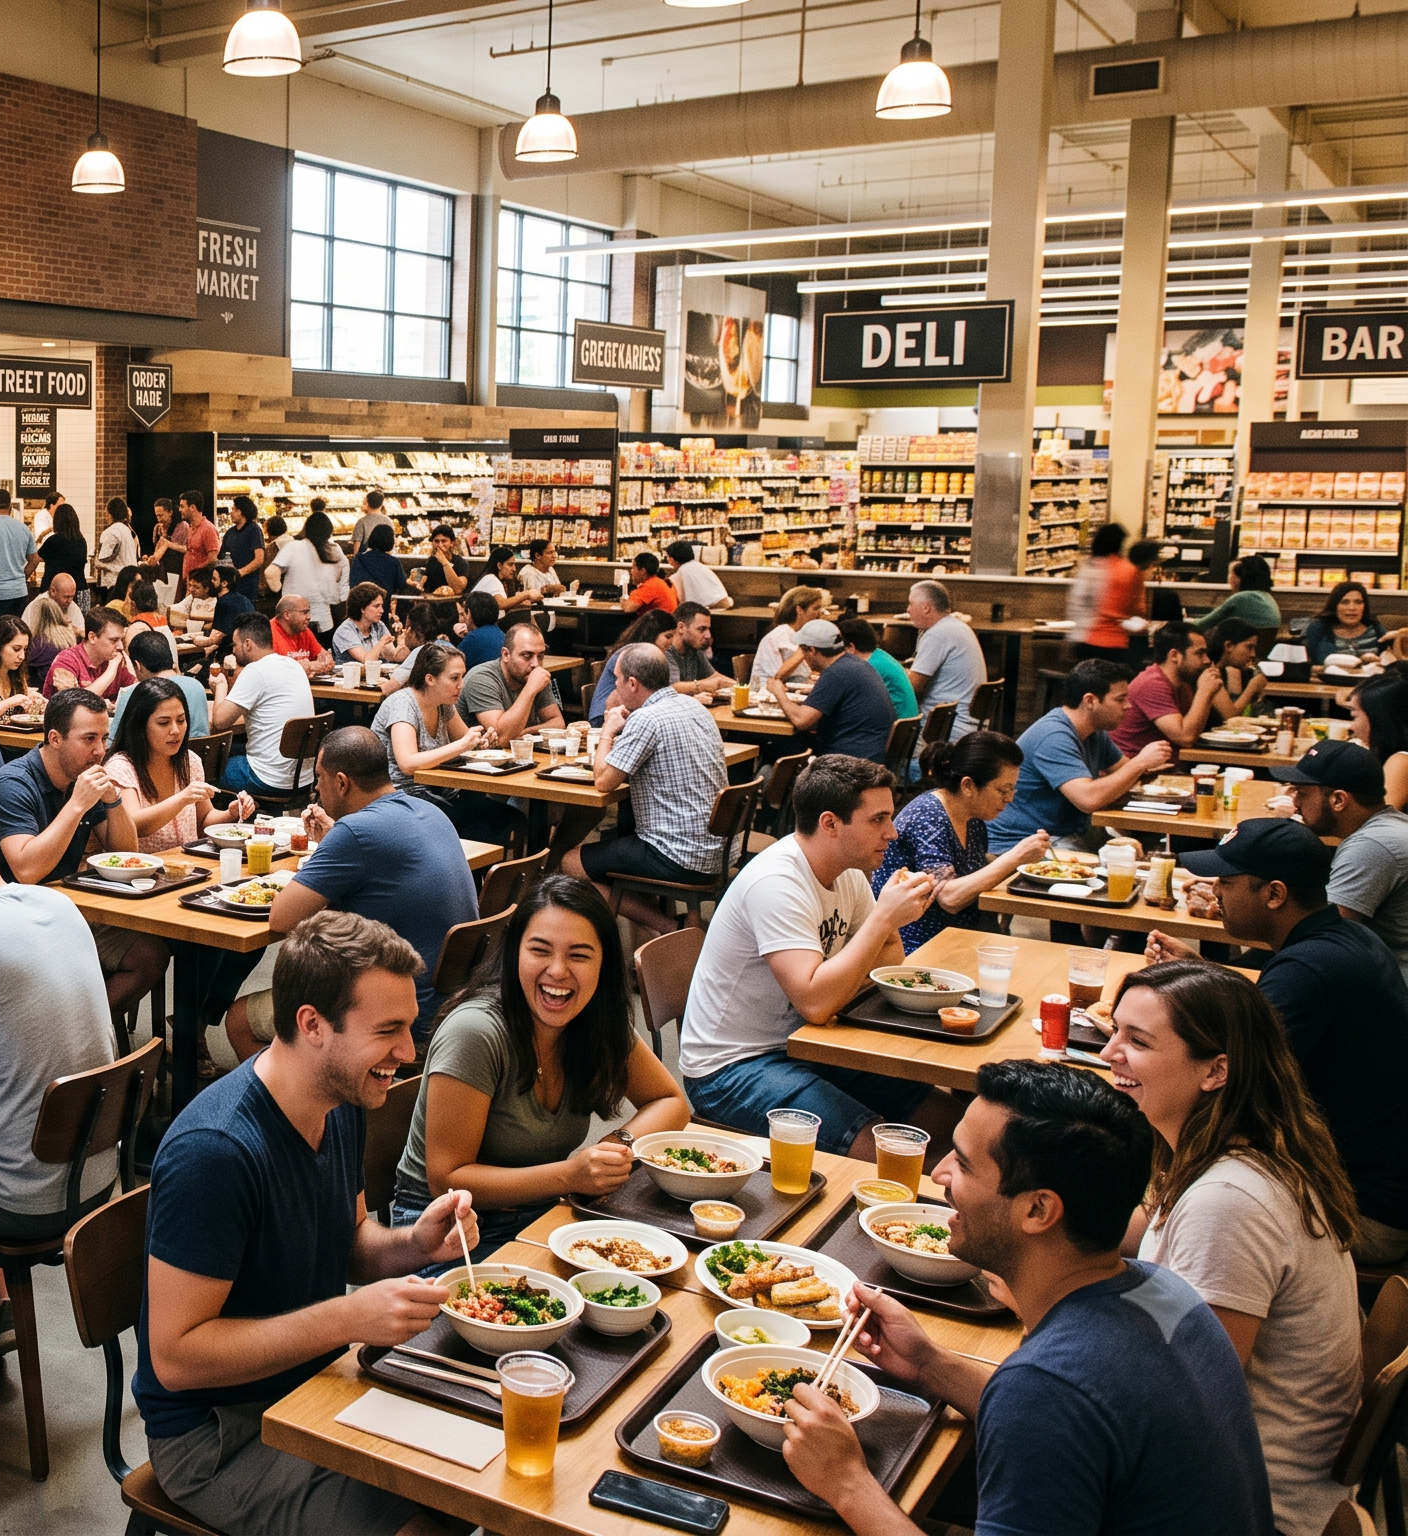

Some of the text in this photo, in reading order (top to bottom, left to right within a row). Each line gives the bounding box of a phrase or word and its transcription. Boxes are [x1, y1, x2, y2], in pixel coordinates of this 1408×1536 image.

[198, 230, 257, 269] FRESH
[196, 268, 260, 301] MARKET
[861, 320, 966, 368] DELI
[1321, 325, 1405, 361] BAR
[47, 371, 87, 396] FOOD
[132, 371, 166, 389] ORDER
